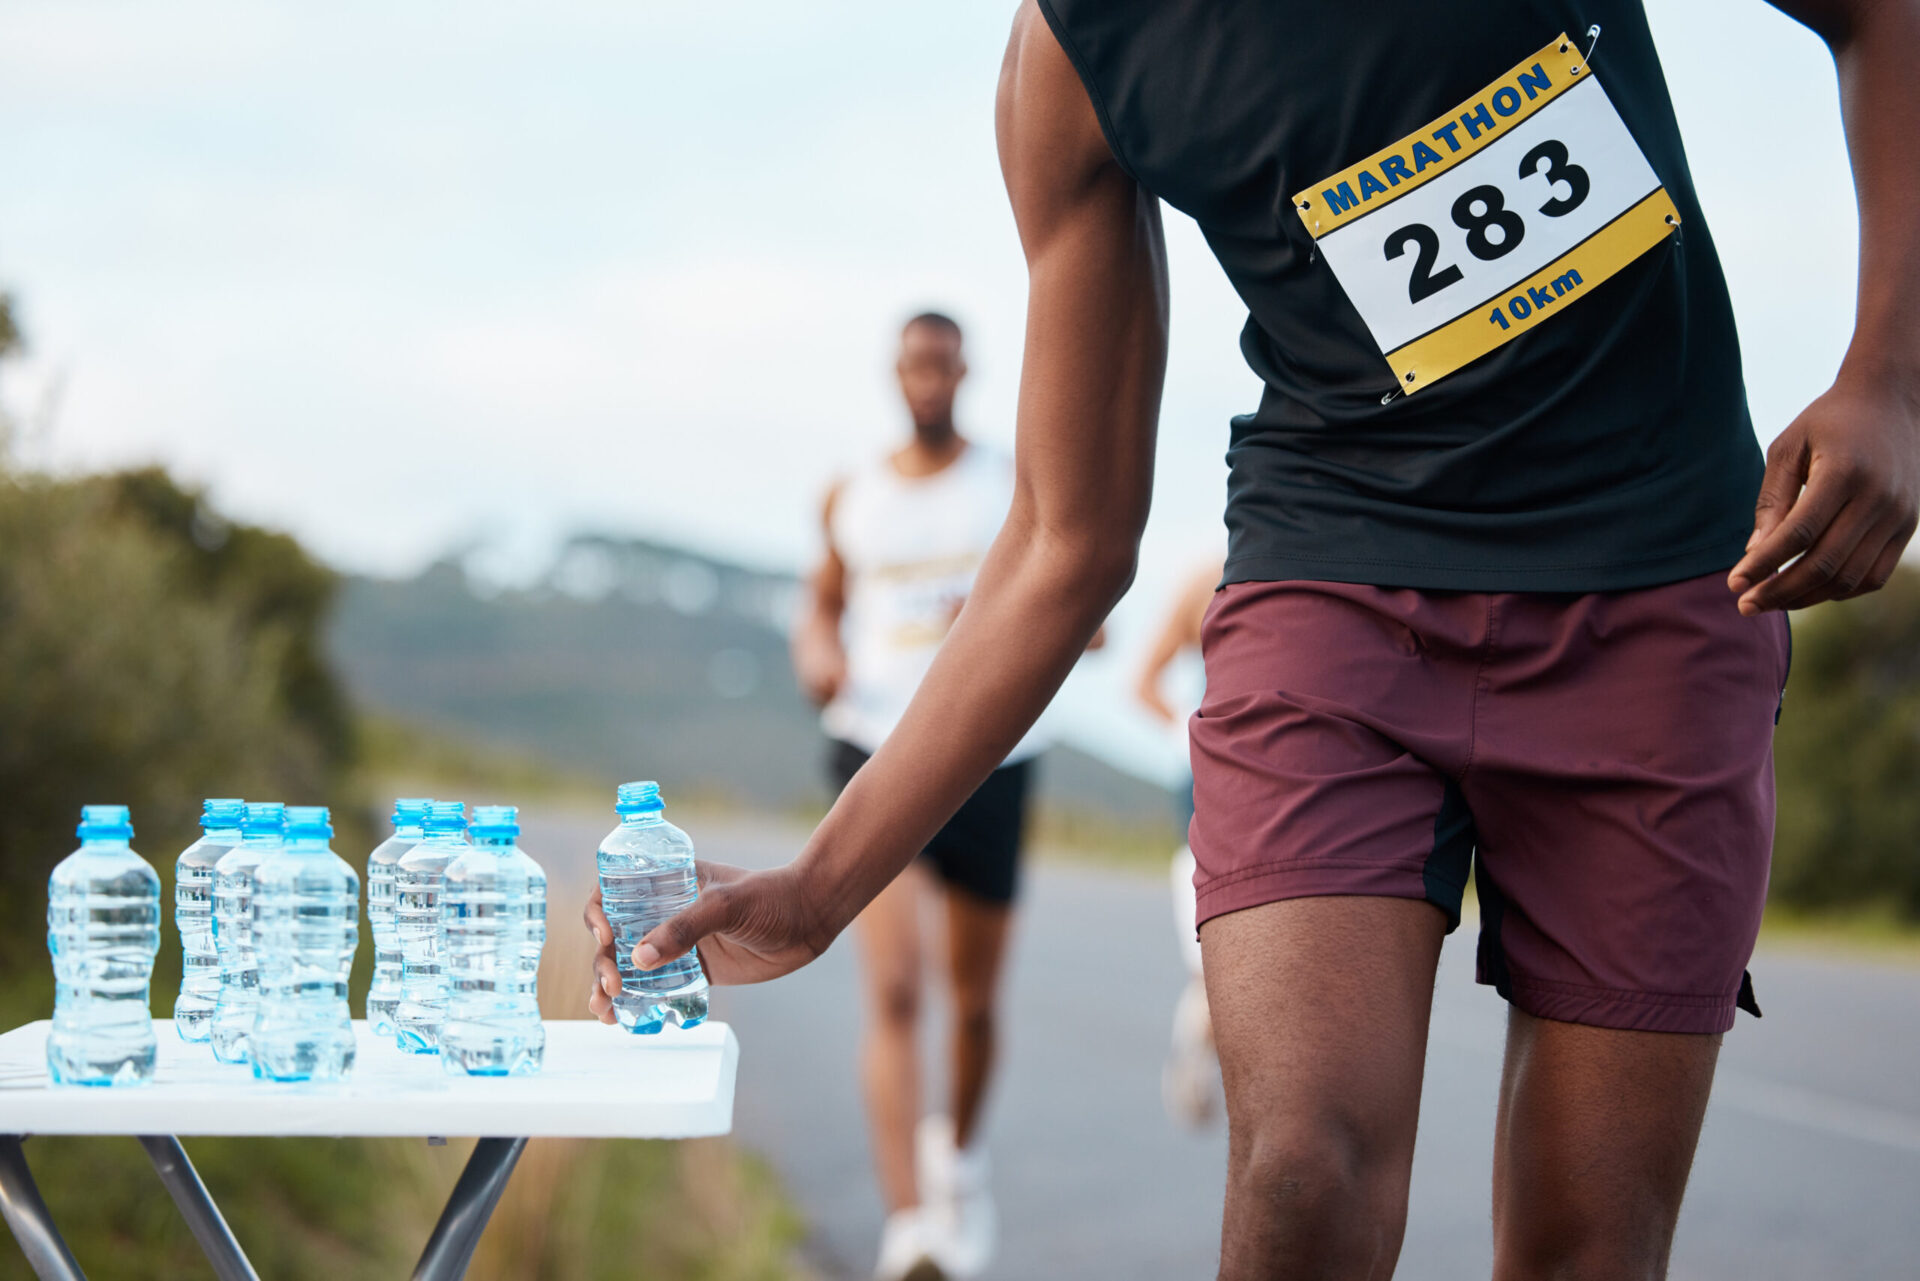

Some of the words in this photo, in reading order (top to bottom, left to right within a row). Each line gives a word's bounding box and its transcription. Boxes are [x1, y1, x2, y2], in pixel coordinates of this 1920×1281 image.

[1322, 63, 1553, 216] MARATHON
[1383, 139, 1591, 305] 283
[1489, 268, 1584, 331] 10km
